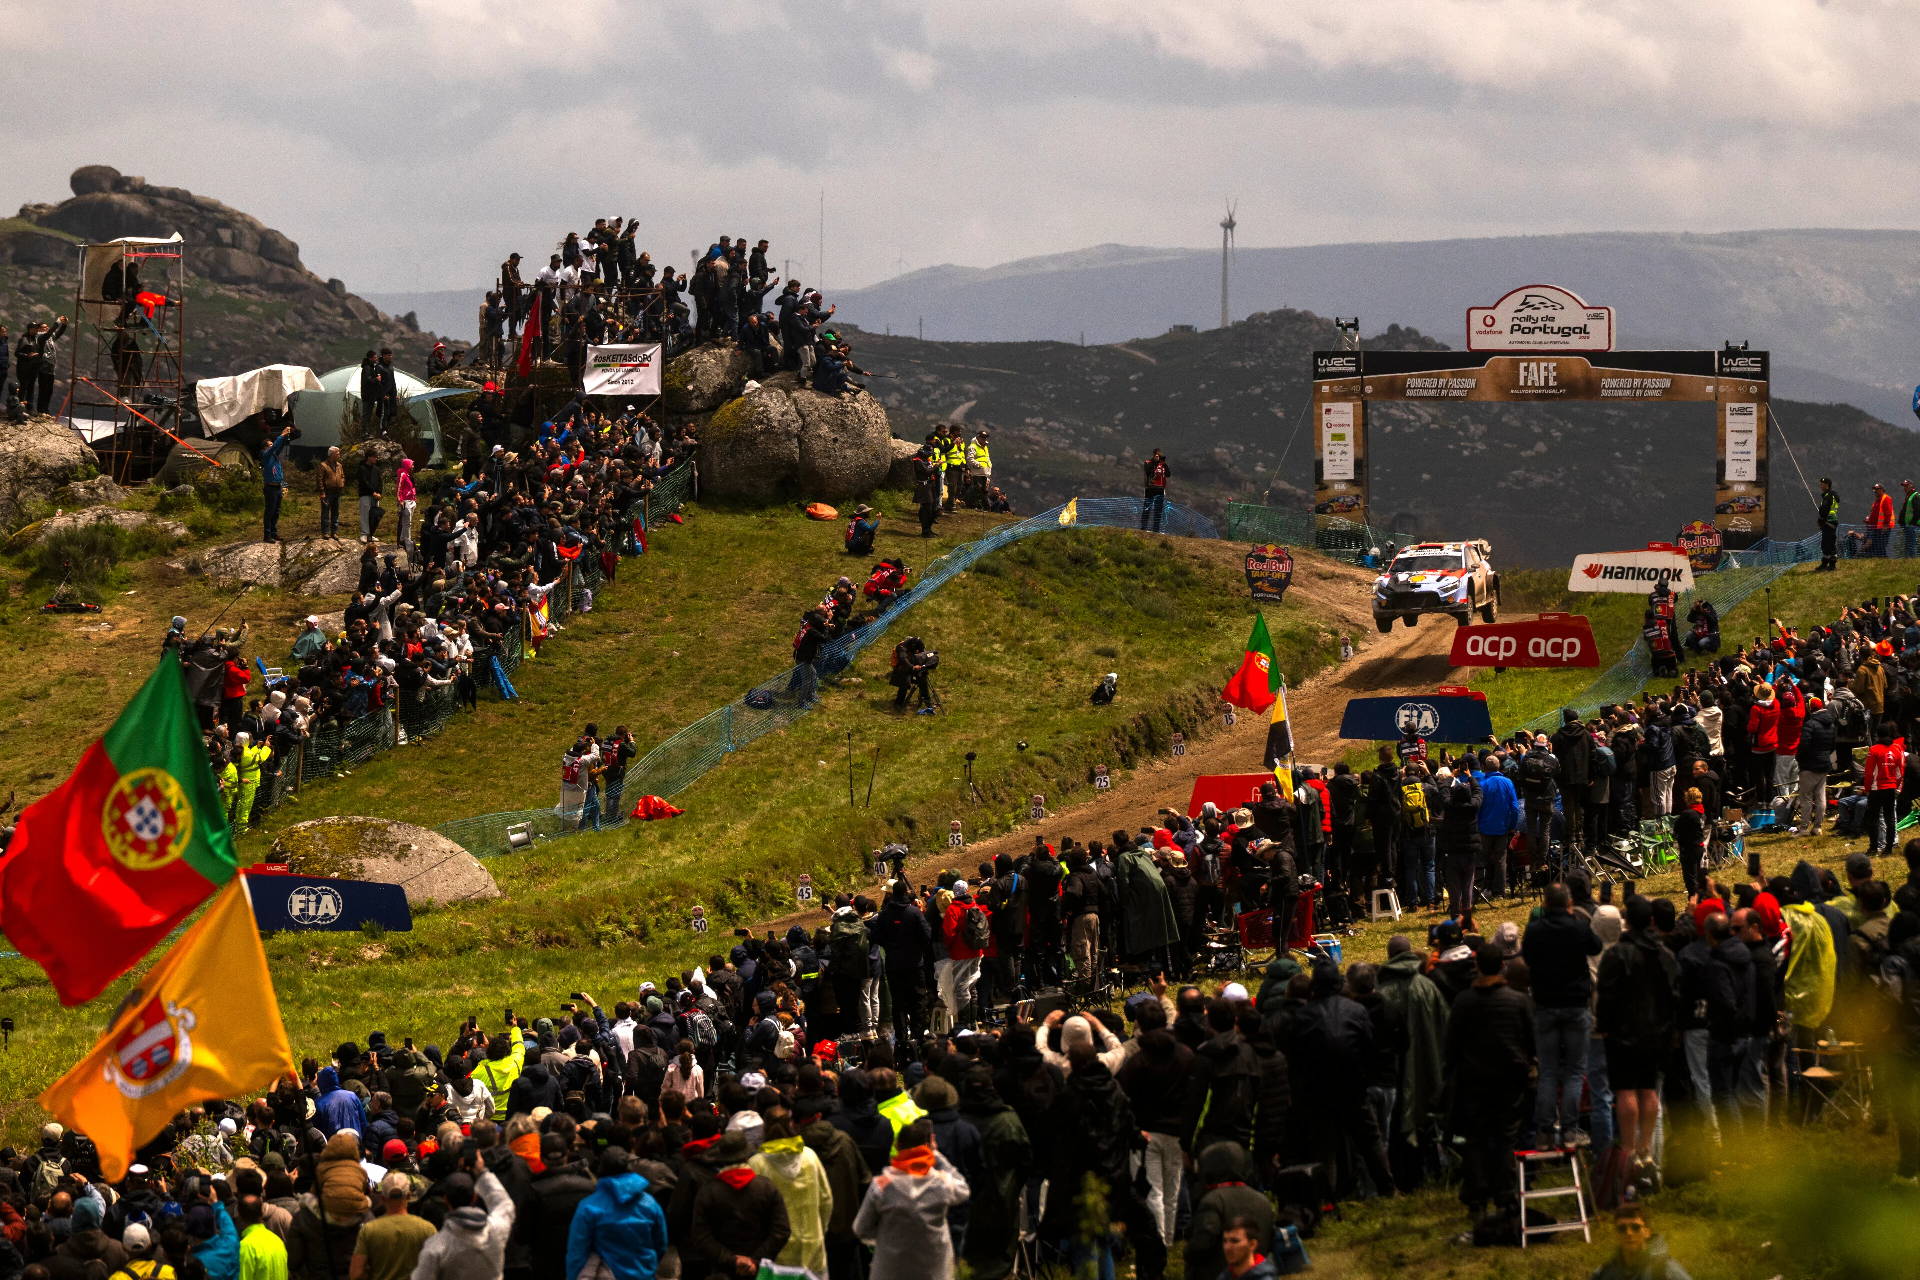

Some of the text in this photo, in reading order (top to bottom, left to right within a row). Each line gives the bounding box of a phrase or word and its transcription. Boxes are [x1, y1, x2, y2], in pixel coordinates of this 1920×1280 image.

[1512, 315, 1538, 324] rally
[1510, 324, 1590, 337] Portugal
[1318, 358, 1356, 366] WRC
[1722, 358, 1762, 366] WRC
[1519, 362, 1557, 386] FAFE
[1406, 378, 1476, 388] POWERED BY PASSION
[1601, 378, 1672, 388] POWERED BY PASSION
[1678, 534, 1720, 549] Red Bull
[1687, 547, 1718, 555] AKE-OFF
[1247, 558, 1292, 572] Red Bull
[1252, 571, 1286, 579] TAKE-OFF
[1344, 647, 1348, 657] 5
[1466, 636, 1581, 661] acp acp
[1224, 714, 1234, 725] 15
[1173, 745, 1184, 755] 20
[1096, 777, 1108, 788] 25
[1032, 808, 1043, 818] 30
[950, 835, 961, 845] 35
[874, 862, 885, 874] 40
[798, 888, 811, 899] 45
[693, 921, 707, 932] 50
